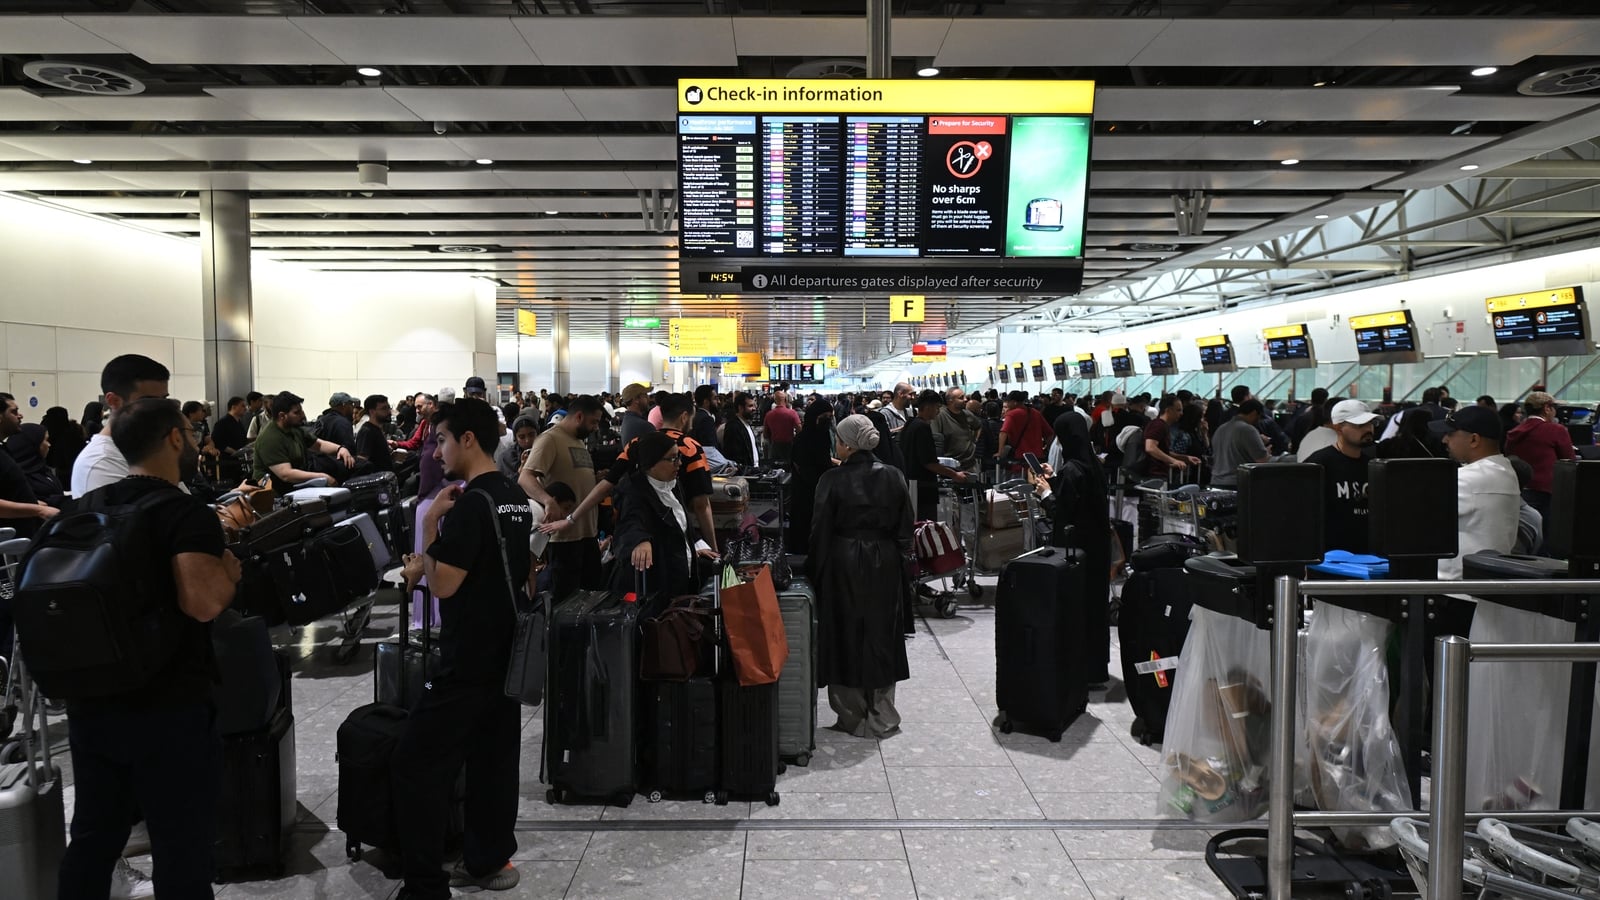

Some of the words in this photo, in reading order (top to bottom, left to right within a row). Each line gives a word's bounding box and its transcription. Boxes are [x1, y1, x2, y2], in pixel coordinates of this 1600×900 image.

[707, 86, 778, 100] Check-in
[784, 86, 883, 100] information
[932, 185, 947, 193] No
[948, 184, 980, 195] sharps
[956, 196, 976, 204] 6cm
[710, 273, 734, 282] 14:54
[770, 275, 786, 286] All
[790, 275, 858, 288] departures
[861, 276, 894, 289] gates
[898, 275, 958, 289] displayed
[961, 275, 991, 286] after
[994, 276, 1043, 289] security
[904, 300, 914, 317] F
